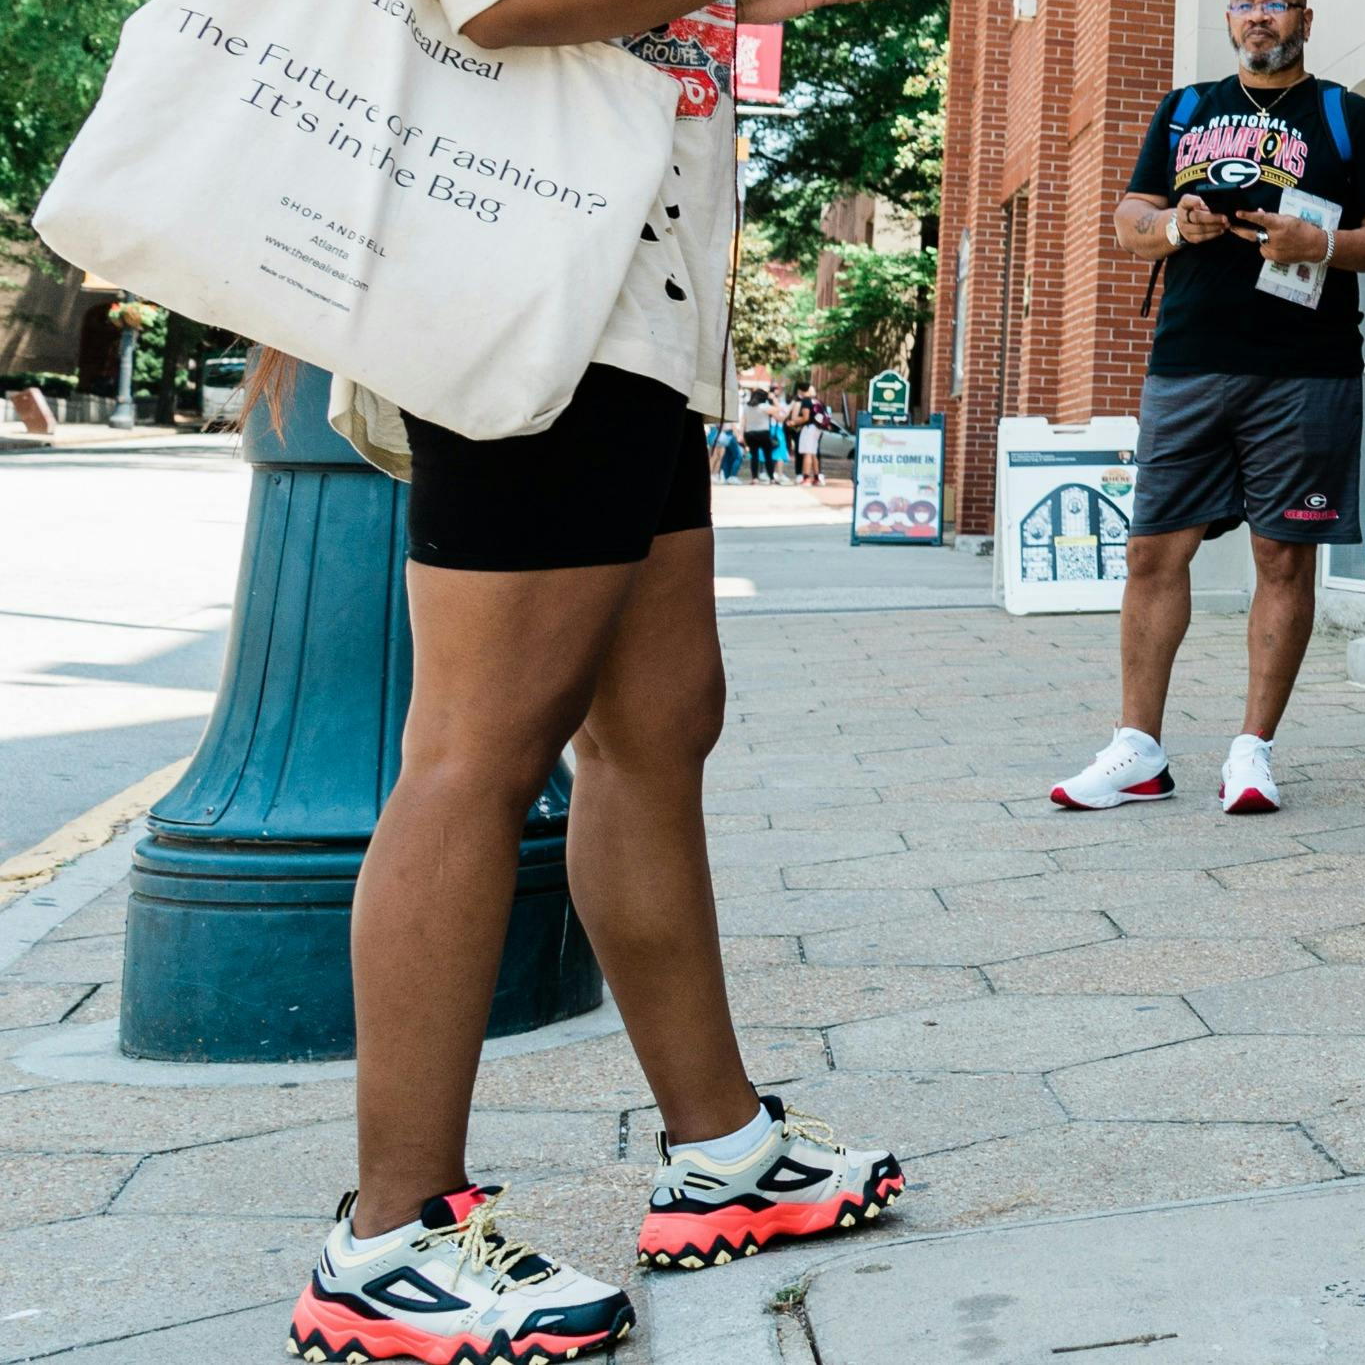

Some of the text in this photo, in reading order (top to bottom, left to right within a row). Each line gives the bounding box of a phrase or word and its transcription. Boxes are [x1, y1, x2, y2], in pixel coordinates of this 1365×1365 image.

[642, 43, 699, 65] ROUTE
[177, 7, 608, 216] The Future of Fashion?
[1208, 114, 1289, 133] NATIONAL
[240, 78, 507, 225] It's in the Bag
[280, 196, 386, 258] SHOP AND SELL
[309, 235, 350, 261] Atlanta
[862, 454, 893, 464] PLEASE
[896, 454, 922, 464] COME
